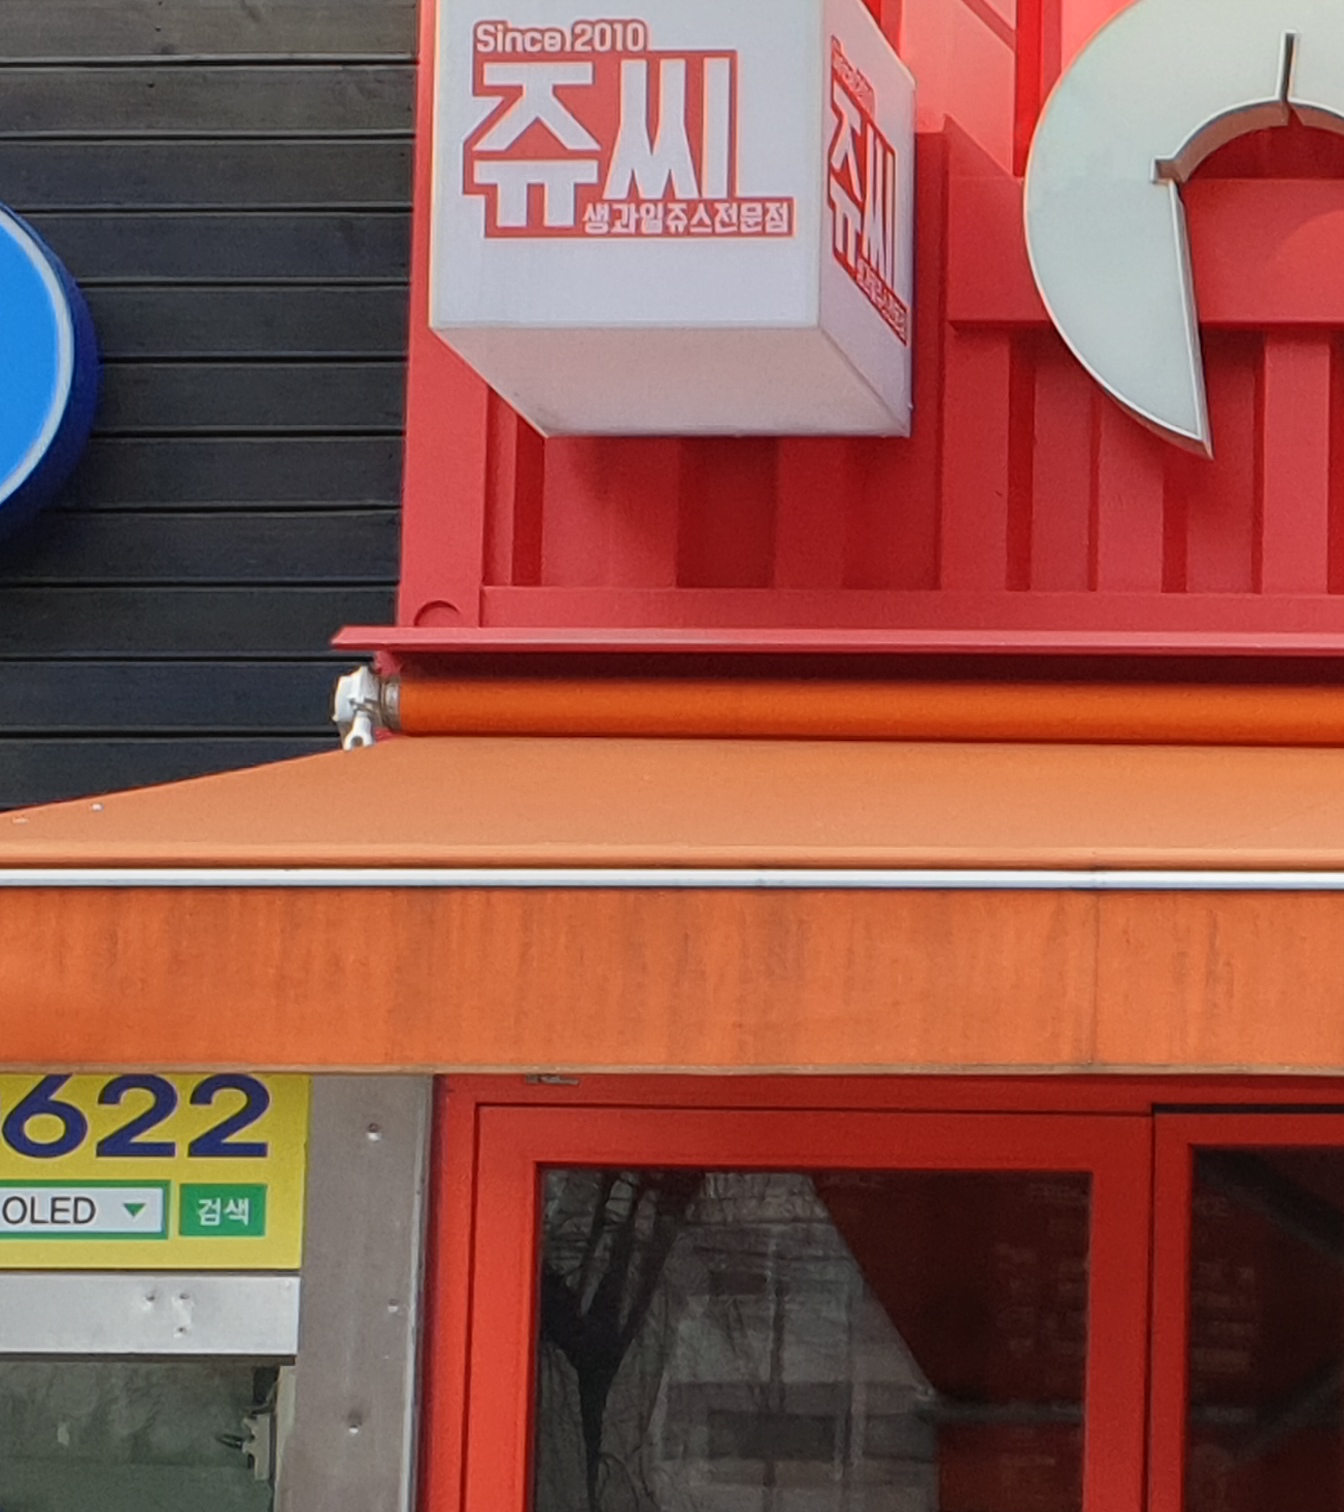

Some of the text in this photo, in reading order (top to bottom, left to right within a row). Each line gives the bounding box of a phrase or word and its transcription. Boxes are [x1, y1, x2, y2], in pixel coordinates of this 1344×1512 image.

[475, 23, 646, 52] Since 2010
[471, 57, 731, 227] 쥬씨
[581, 201, 791, 235] 생과일쥬스전문점
[2, 1197, 250, 1226] OLED 검색
